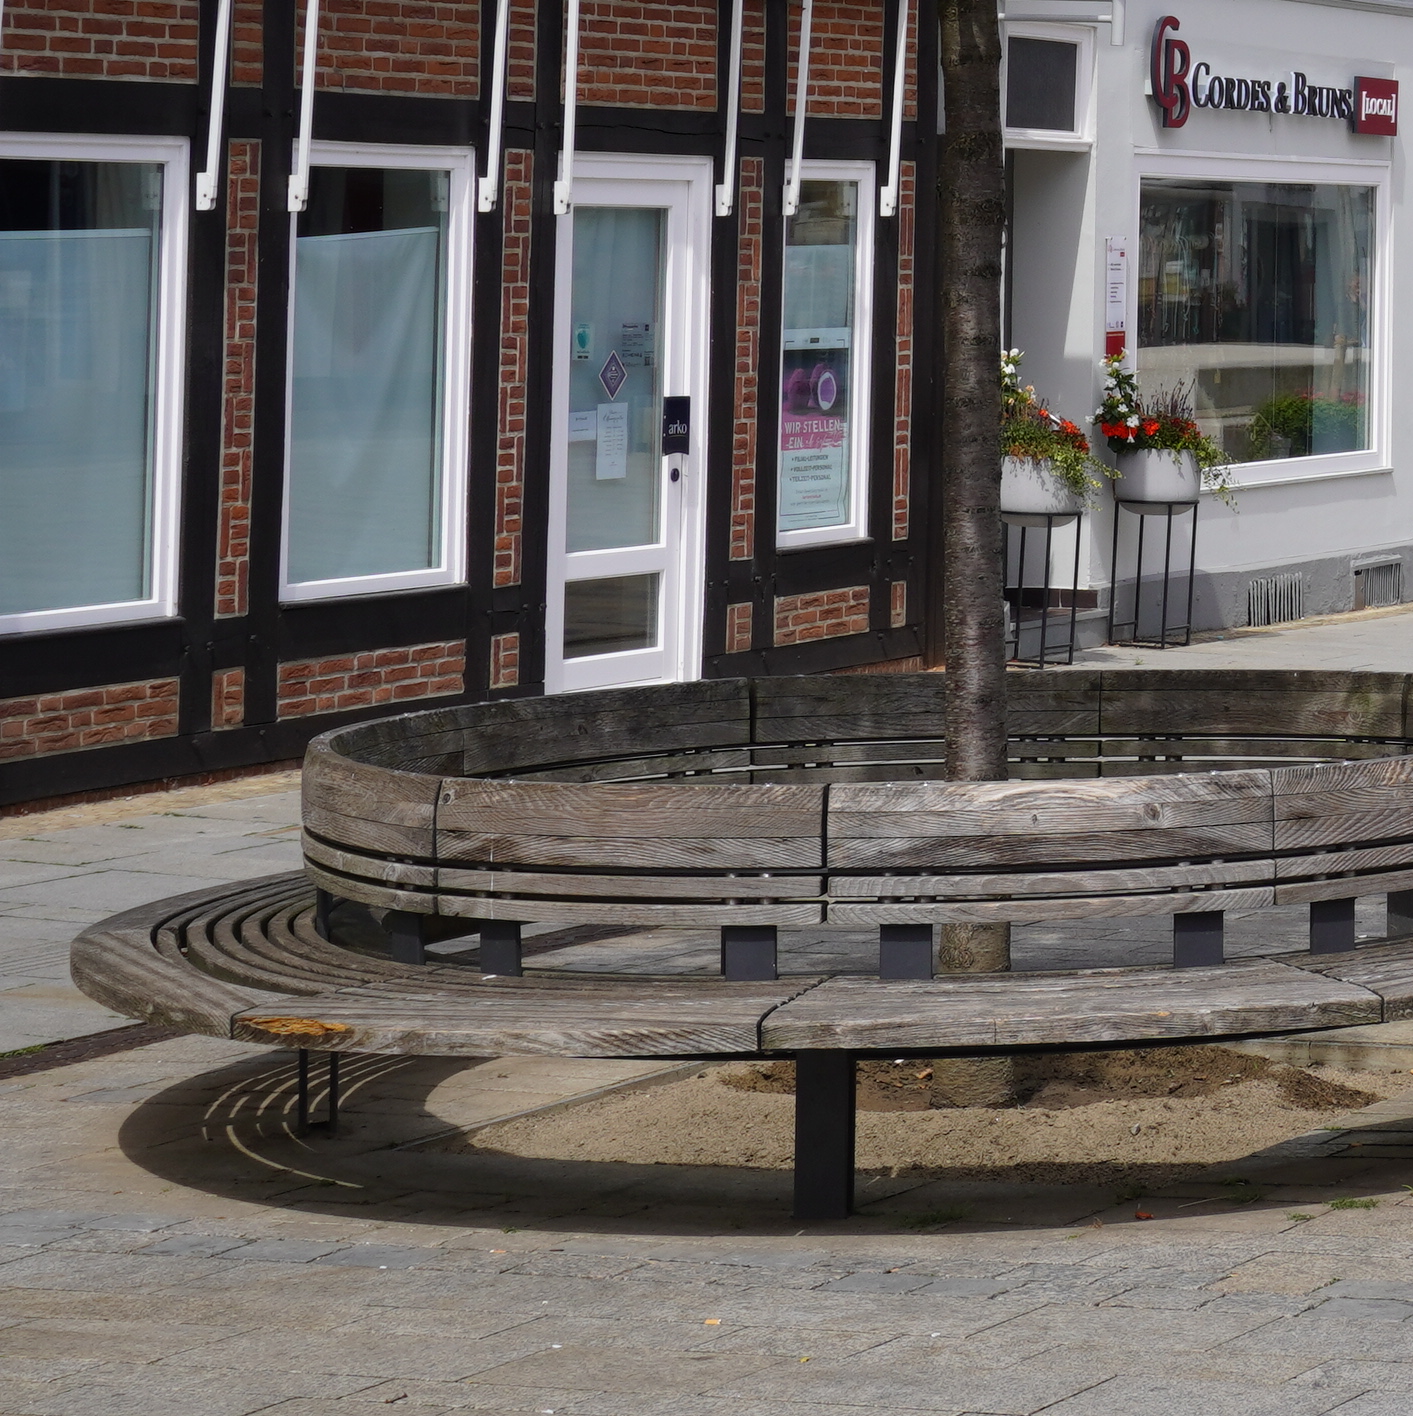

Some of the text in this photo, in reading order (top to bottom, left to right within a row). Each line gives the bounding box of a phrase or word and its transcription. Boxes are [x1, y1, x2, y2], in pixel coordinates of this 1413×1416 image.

[1274, 81, 1292, 114] &
[668, 420, 688, 434] arko
[784, 419, 841, 434] WIR STELLEN
